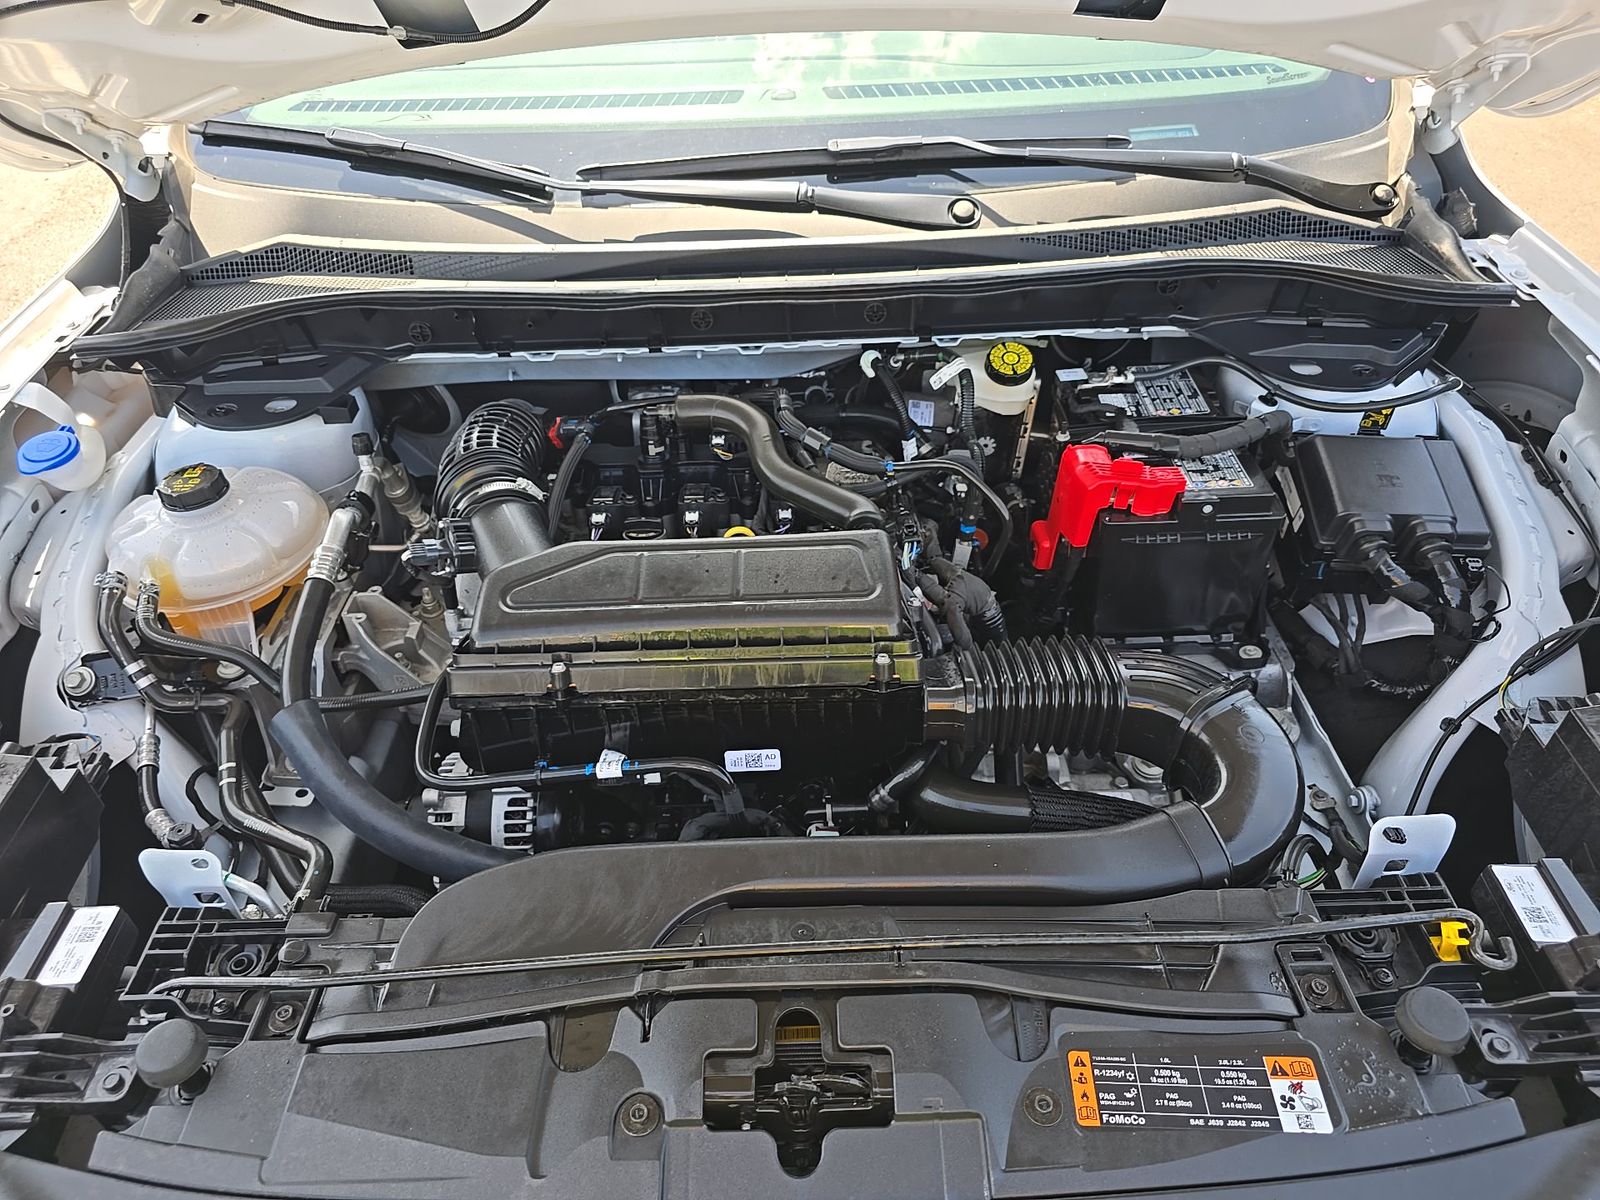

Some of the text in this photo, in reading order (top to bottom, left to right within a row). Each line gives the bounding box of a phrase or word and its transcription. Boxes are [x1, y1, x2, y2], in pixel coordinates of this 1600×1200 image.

[1094, 1069, 1125, 1079] R-1234yf
[1172, 1070, 1180, 1078] kg
[1238, 1071, 1247, 1079] kg
[1098, 1092, 1116, 1100] PAG
[1102, 1114, 1146, 1125] FoMoCo
